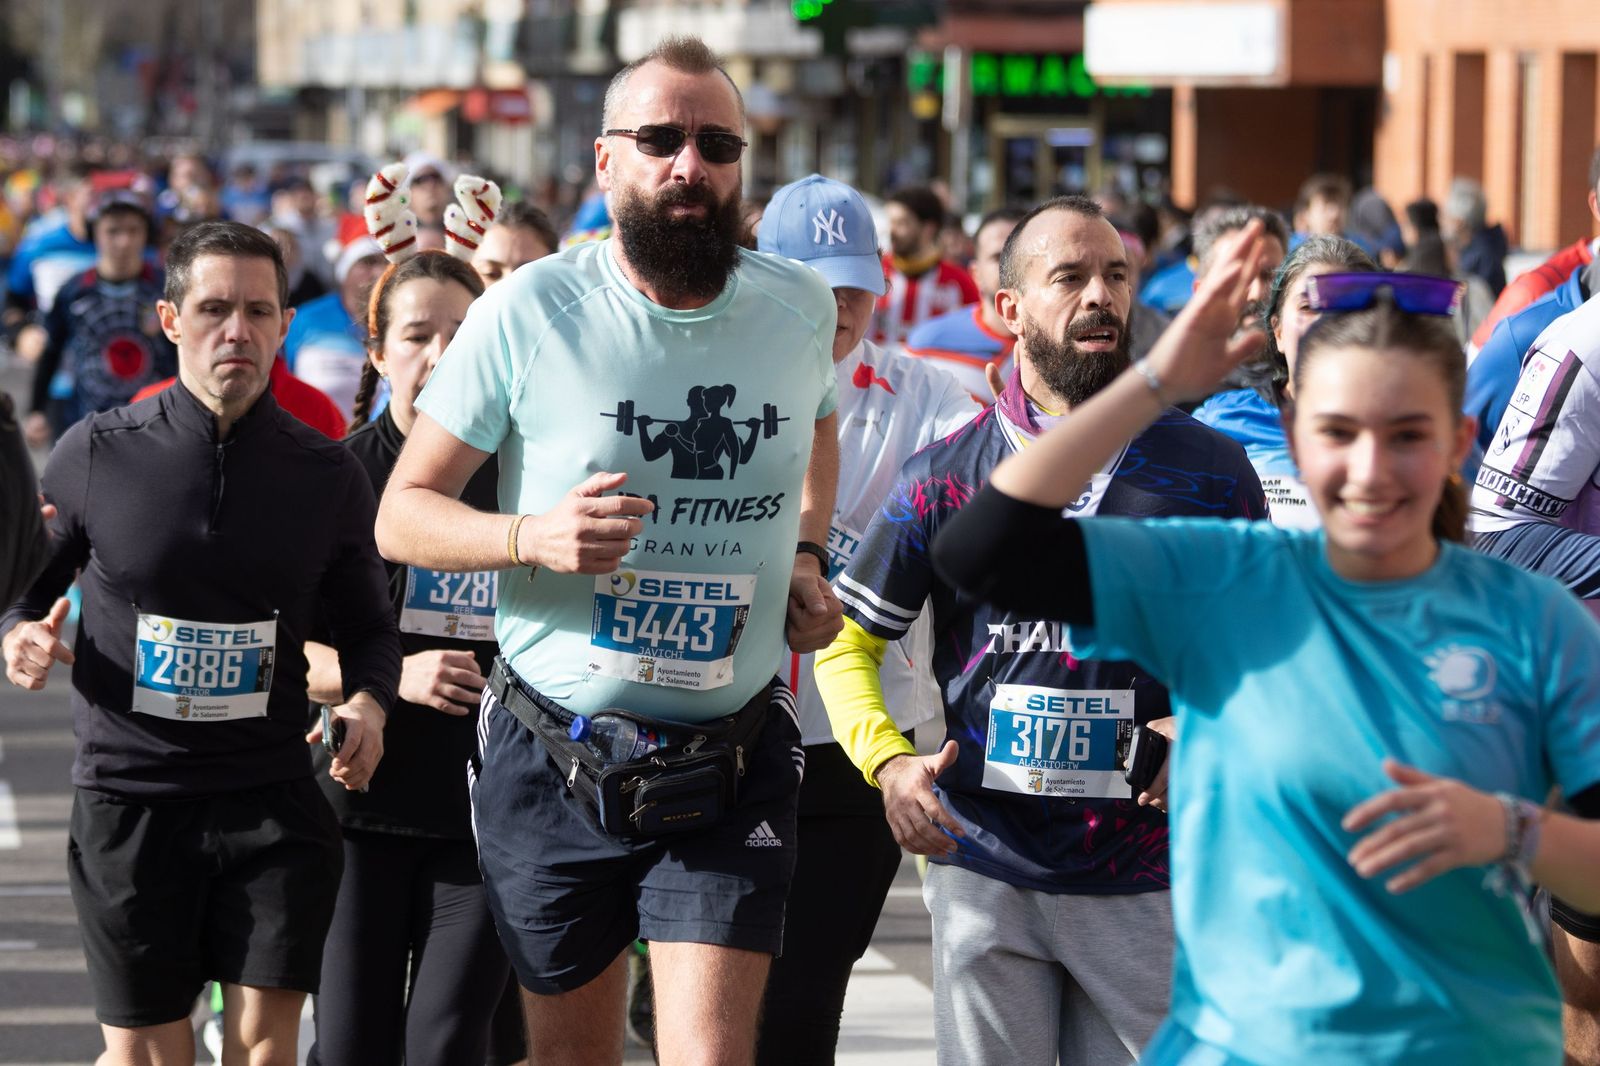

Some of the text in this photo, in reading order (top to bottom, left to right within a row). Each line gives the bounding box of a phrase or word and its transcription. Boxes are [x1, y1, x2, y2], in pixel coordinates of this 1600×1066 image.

[812, 208, 848, 246] NY
[670, 492, 786, 527] FITNESS
[630, 537, 743, 557] GRAN VÍA
[429, 570, 499, 609] 3281
[639, 578, 740, 601] SETEL
[612, 599, 717, 652] 5443
[175, 626, 263, 645] SETEL
[639, 646, 685, 660] JAVICHI
[151, 644, 244, 688] 2886
[657, 667, 702, 678] Ayuntamiento
[656, 675, 700, 687] de Salamanca
[180, 688, 211, 697] AITOR
[1027, 694, 1120, 714] SETEL
[1011, 714, 1092, 761] 3176
[1018, 758, 1080, 770] ALEXITOFTW
[1045, 777, 1086, 786] Ayuntamiento
[1045, 785, 1053, 793] de
[745, 837, 783, 848] adidas
